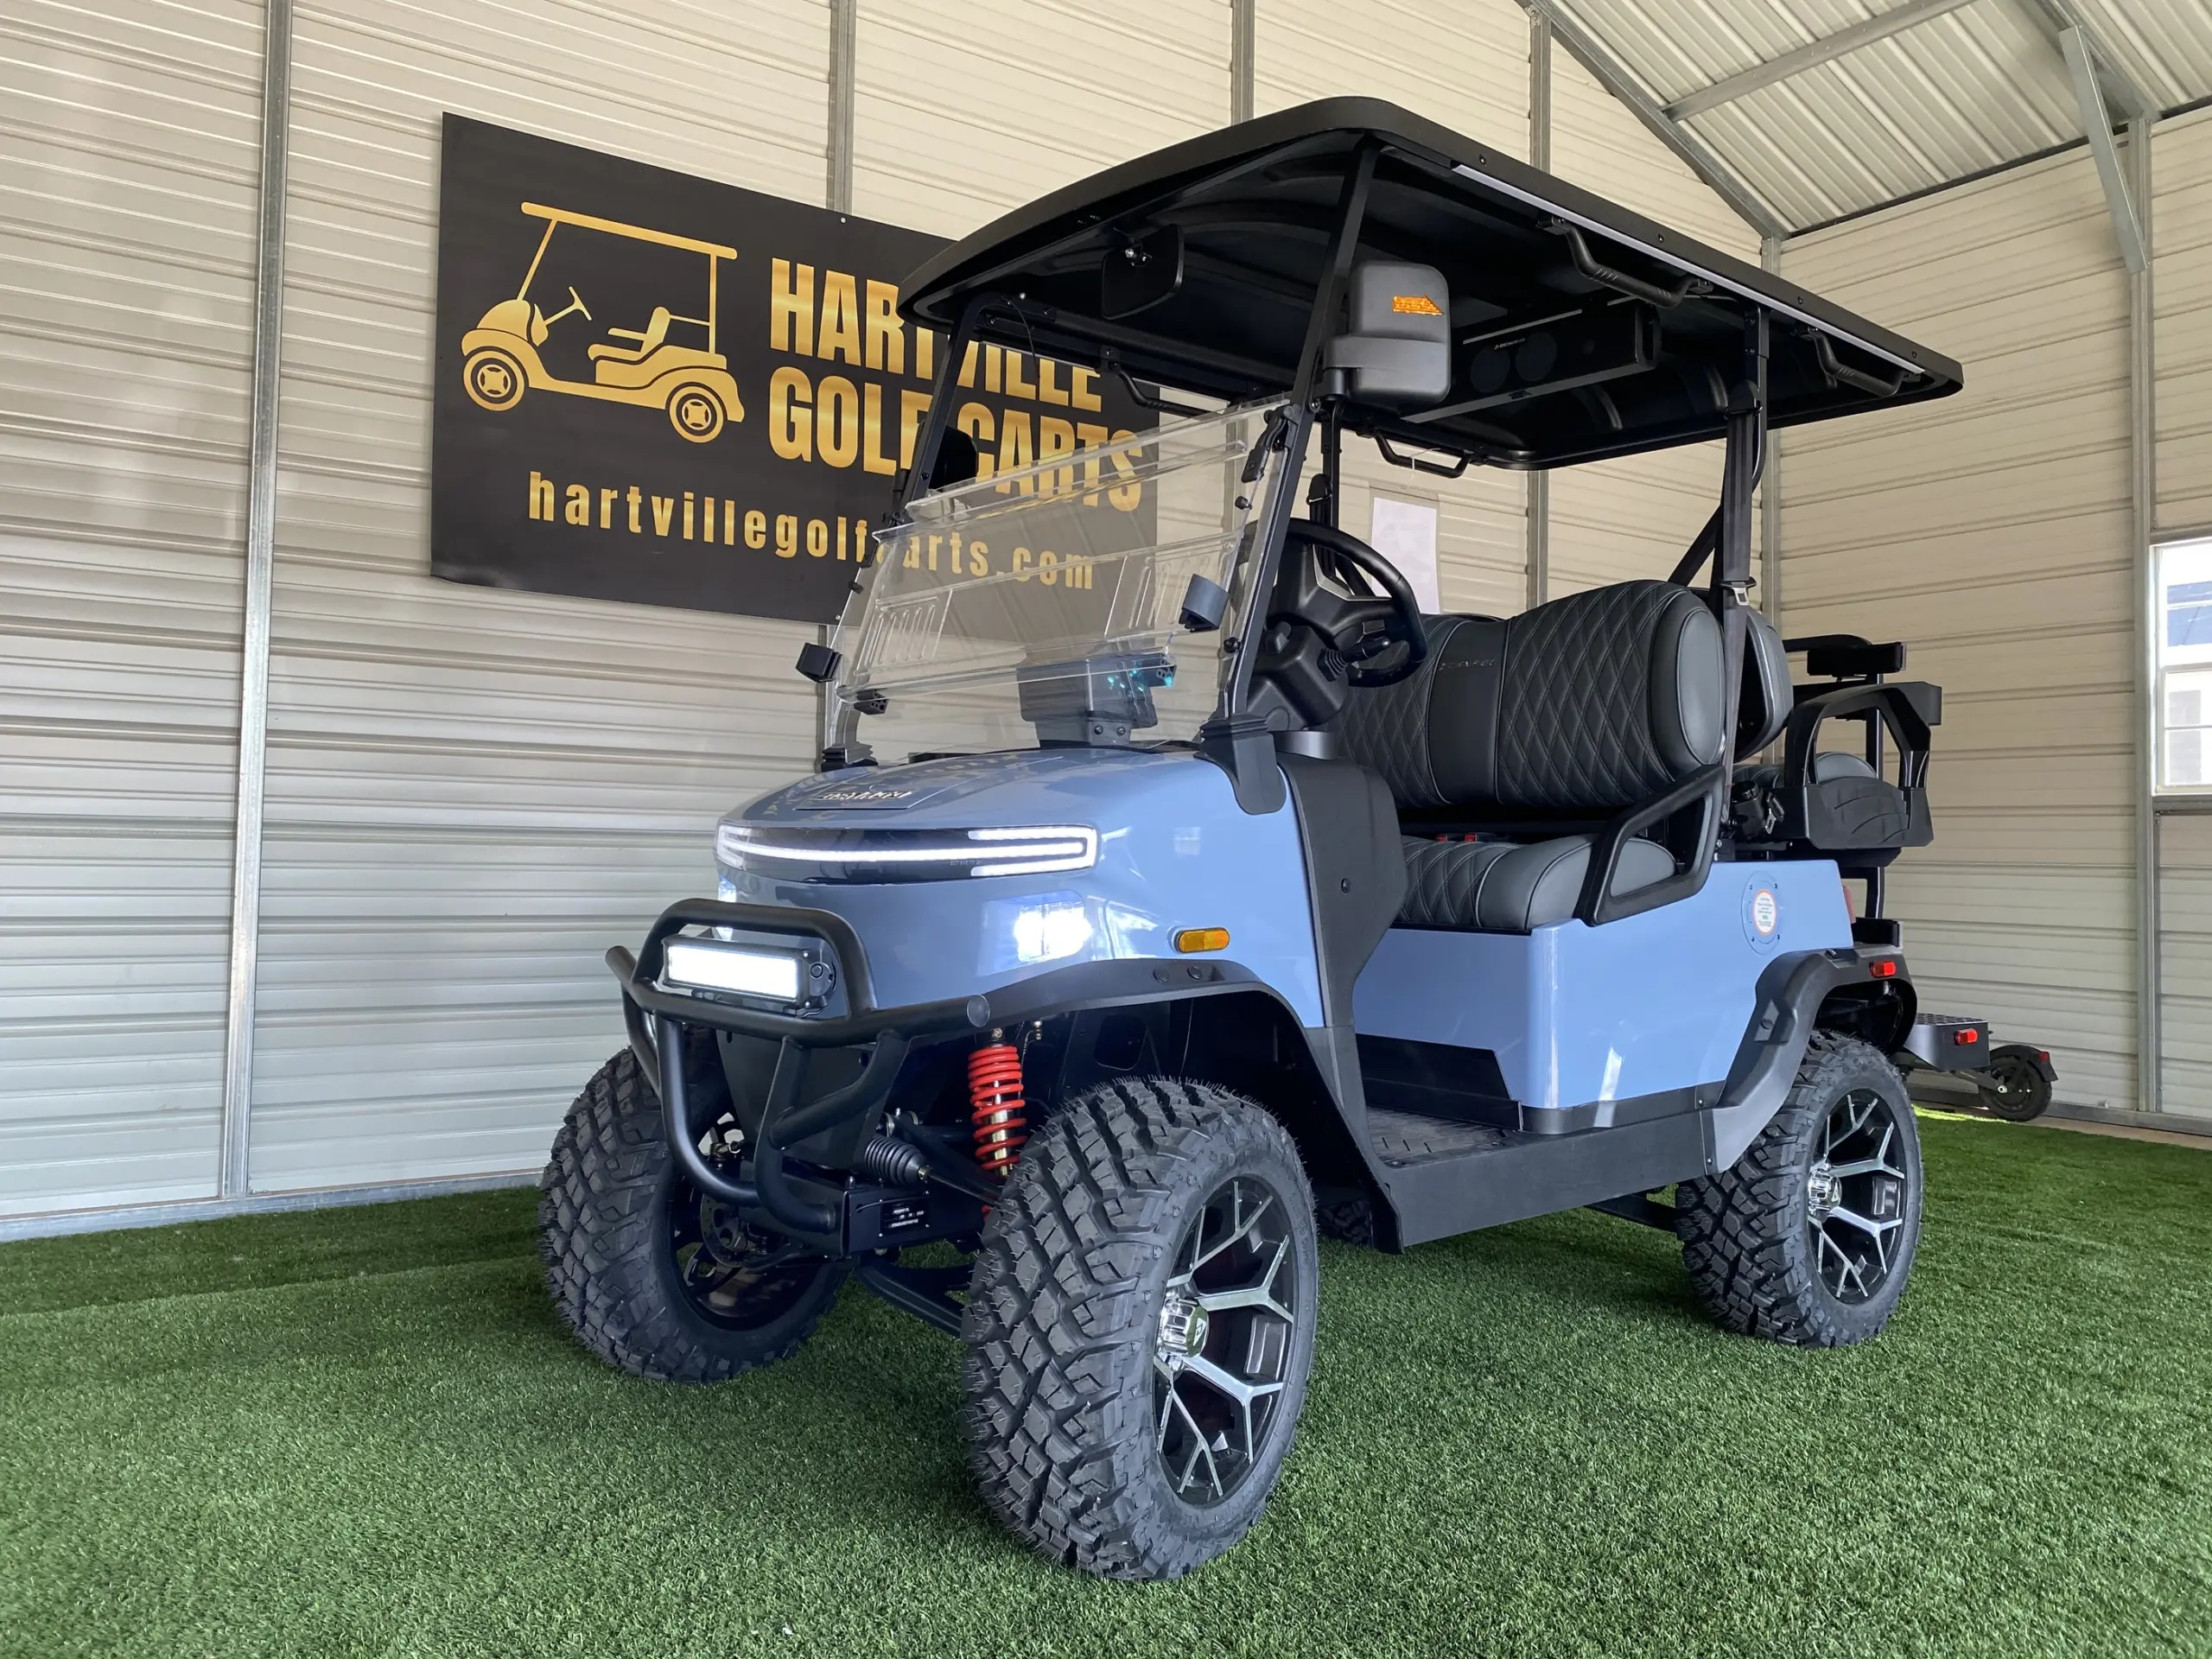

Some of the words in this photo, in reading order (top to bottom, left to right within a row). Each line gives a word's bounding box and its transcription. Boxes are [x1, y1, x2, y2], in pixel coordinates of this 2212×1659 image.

[769, 366, 933, 476] GOLF
[957, 402, 1143, 512] CARTS
[529, 471, 1093, 589] hartvillegolfarts.com
